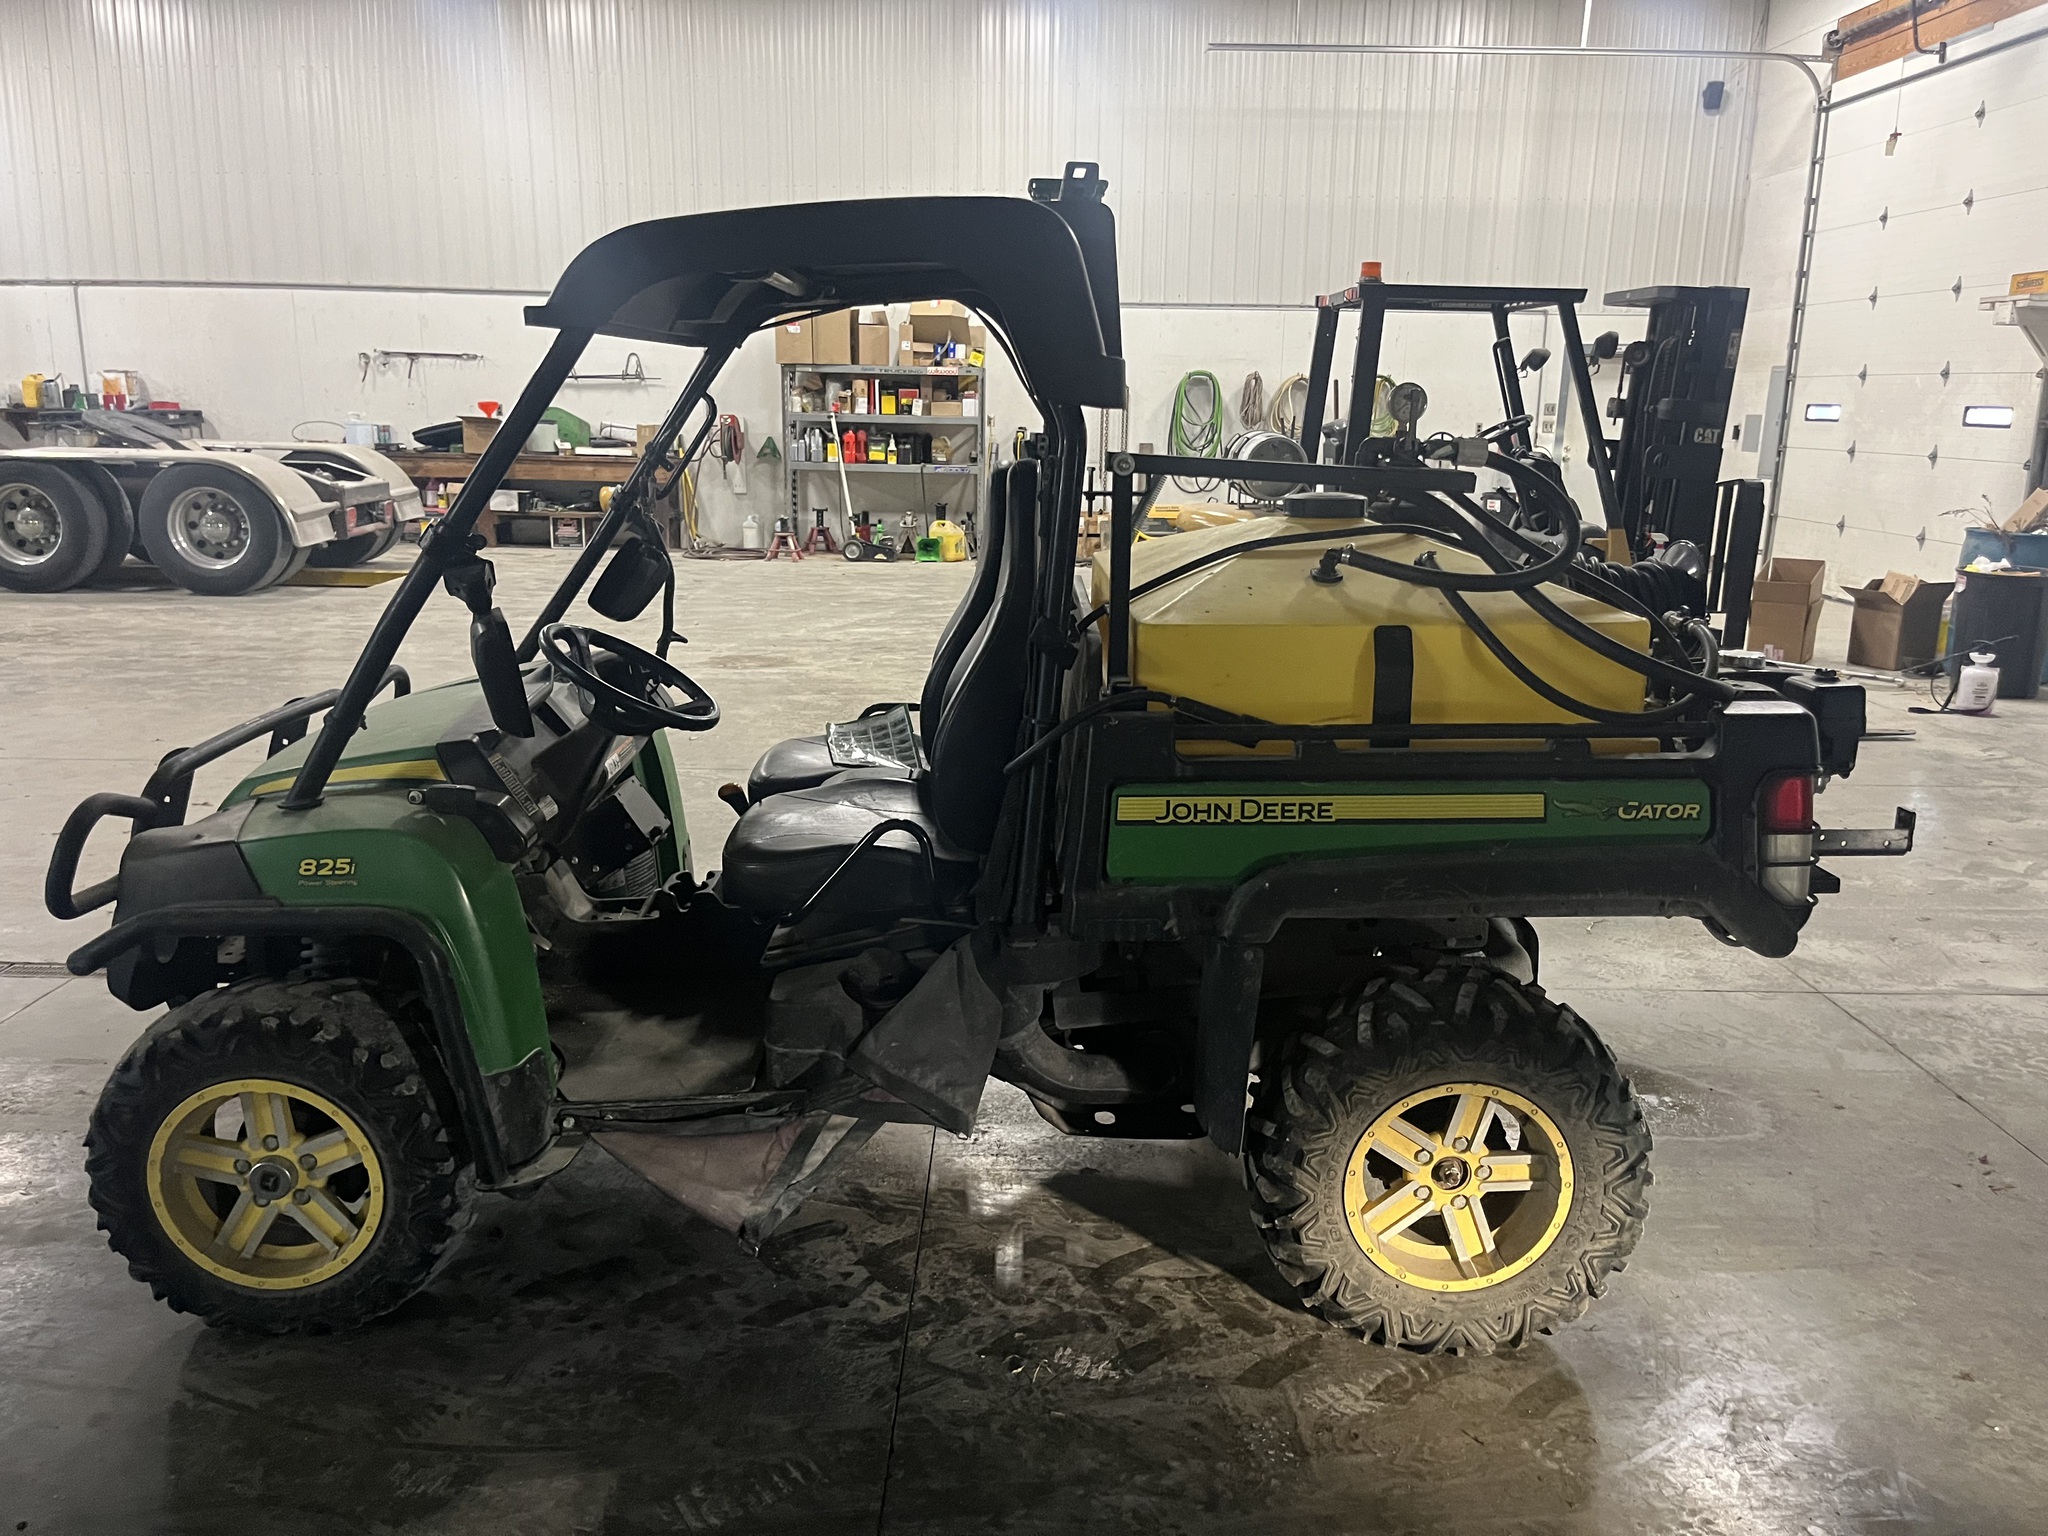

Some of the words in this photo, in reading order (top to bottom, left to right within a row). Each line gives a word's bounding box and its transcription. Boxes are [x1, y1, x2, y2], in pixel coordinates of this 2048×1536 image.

[1694, 427, 1721, 444] CAT
[1155, 799, 1233, 823] JOHN
[1240, 799, 1336, 822] DEERE
[1618, 801, 1701, 819] GATOR
[298, 858, 356, 876] 825i
